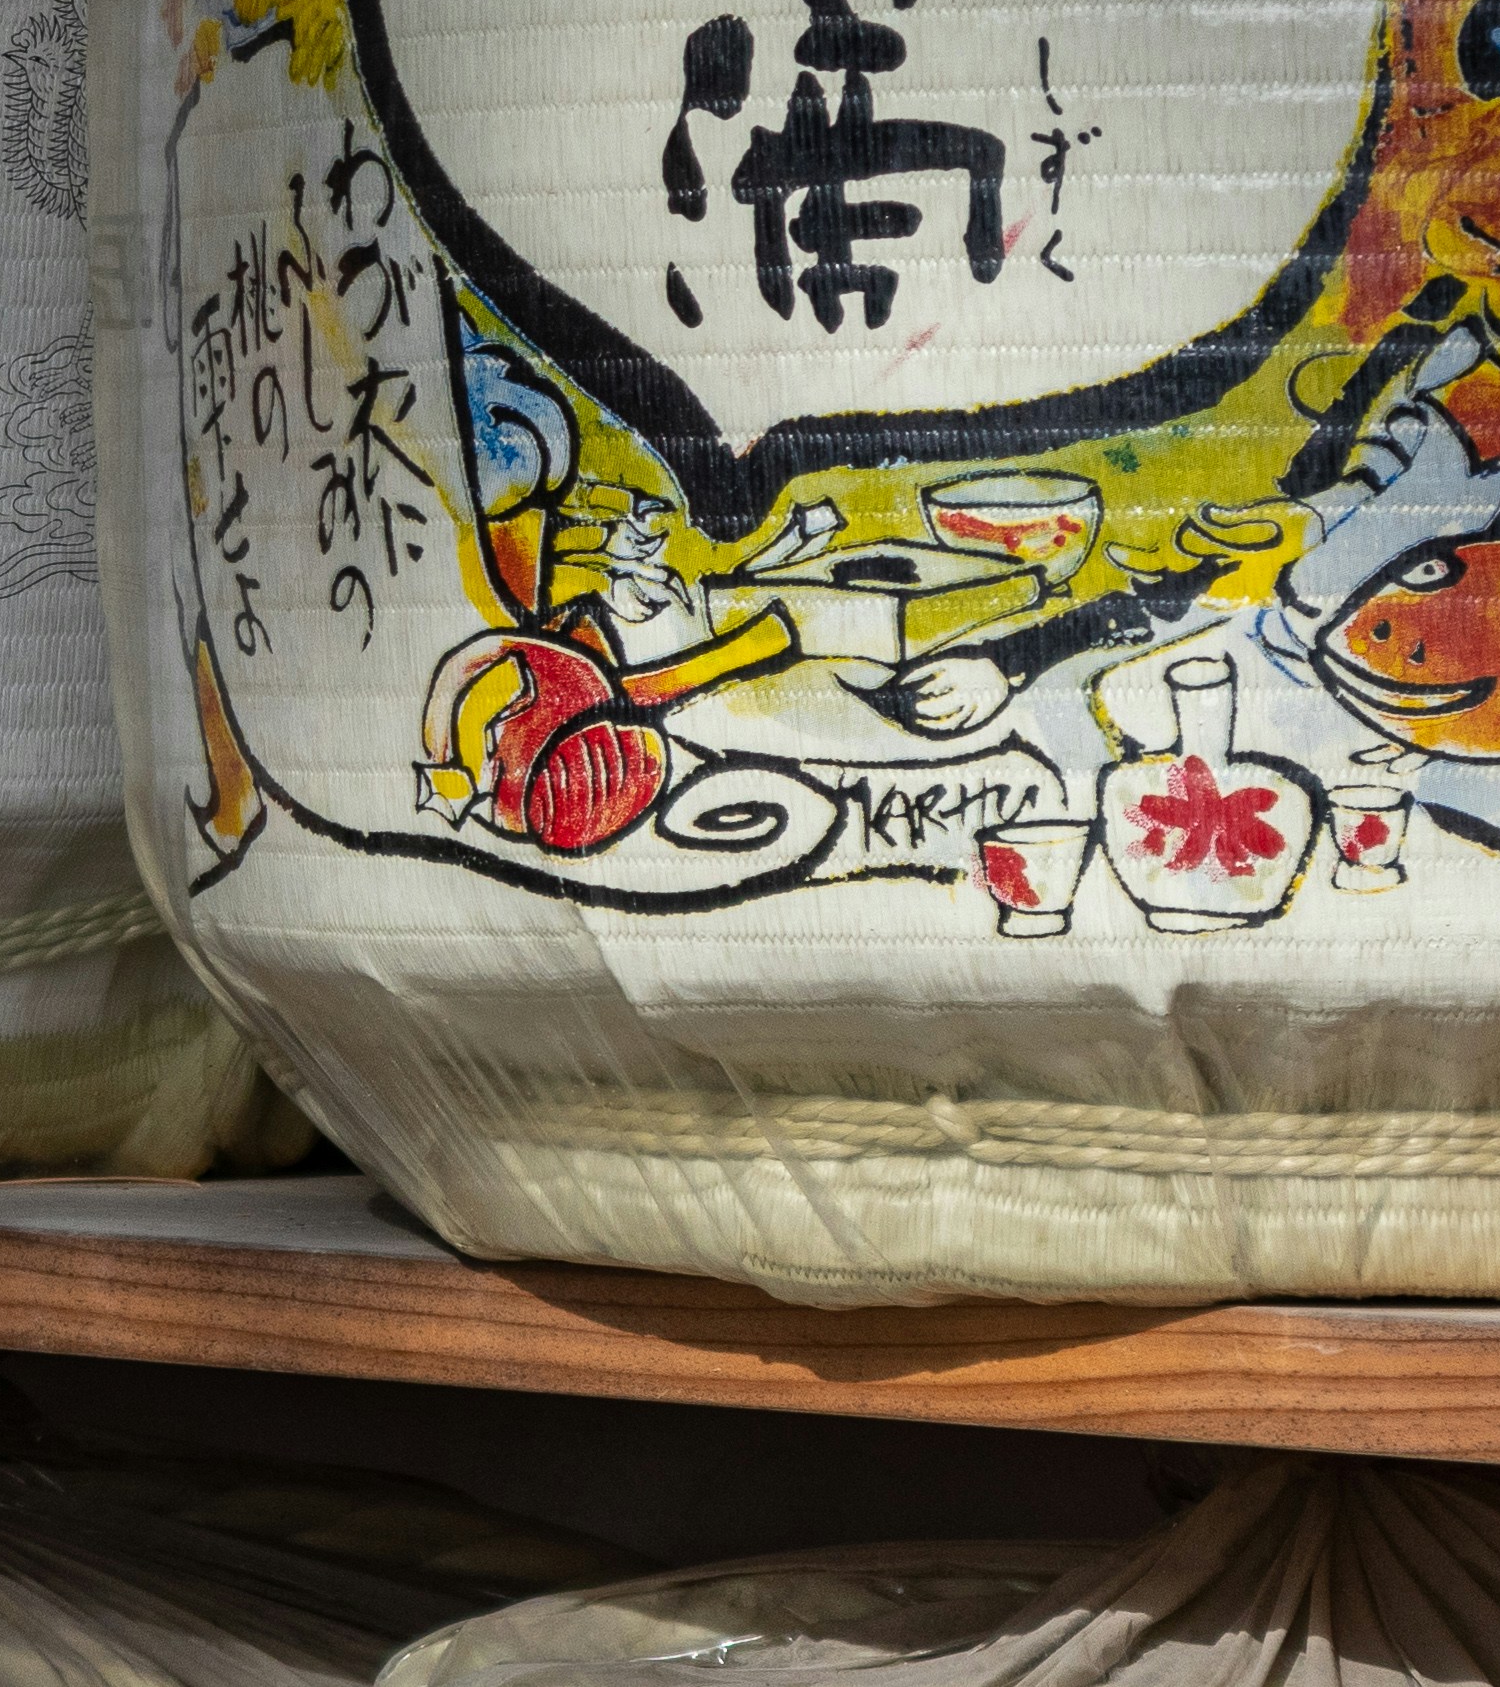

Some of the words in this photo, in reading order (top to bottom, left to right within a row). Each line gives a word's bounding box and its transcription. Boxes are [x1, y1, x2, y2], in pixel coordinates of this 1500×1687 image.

[1031, 36, 1103, 283] しずく
[852, 775, 1040, 853] KARHU
